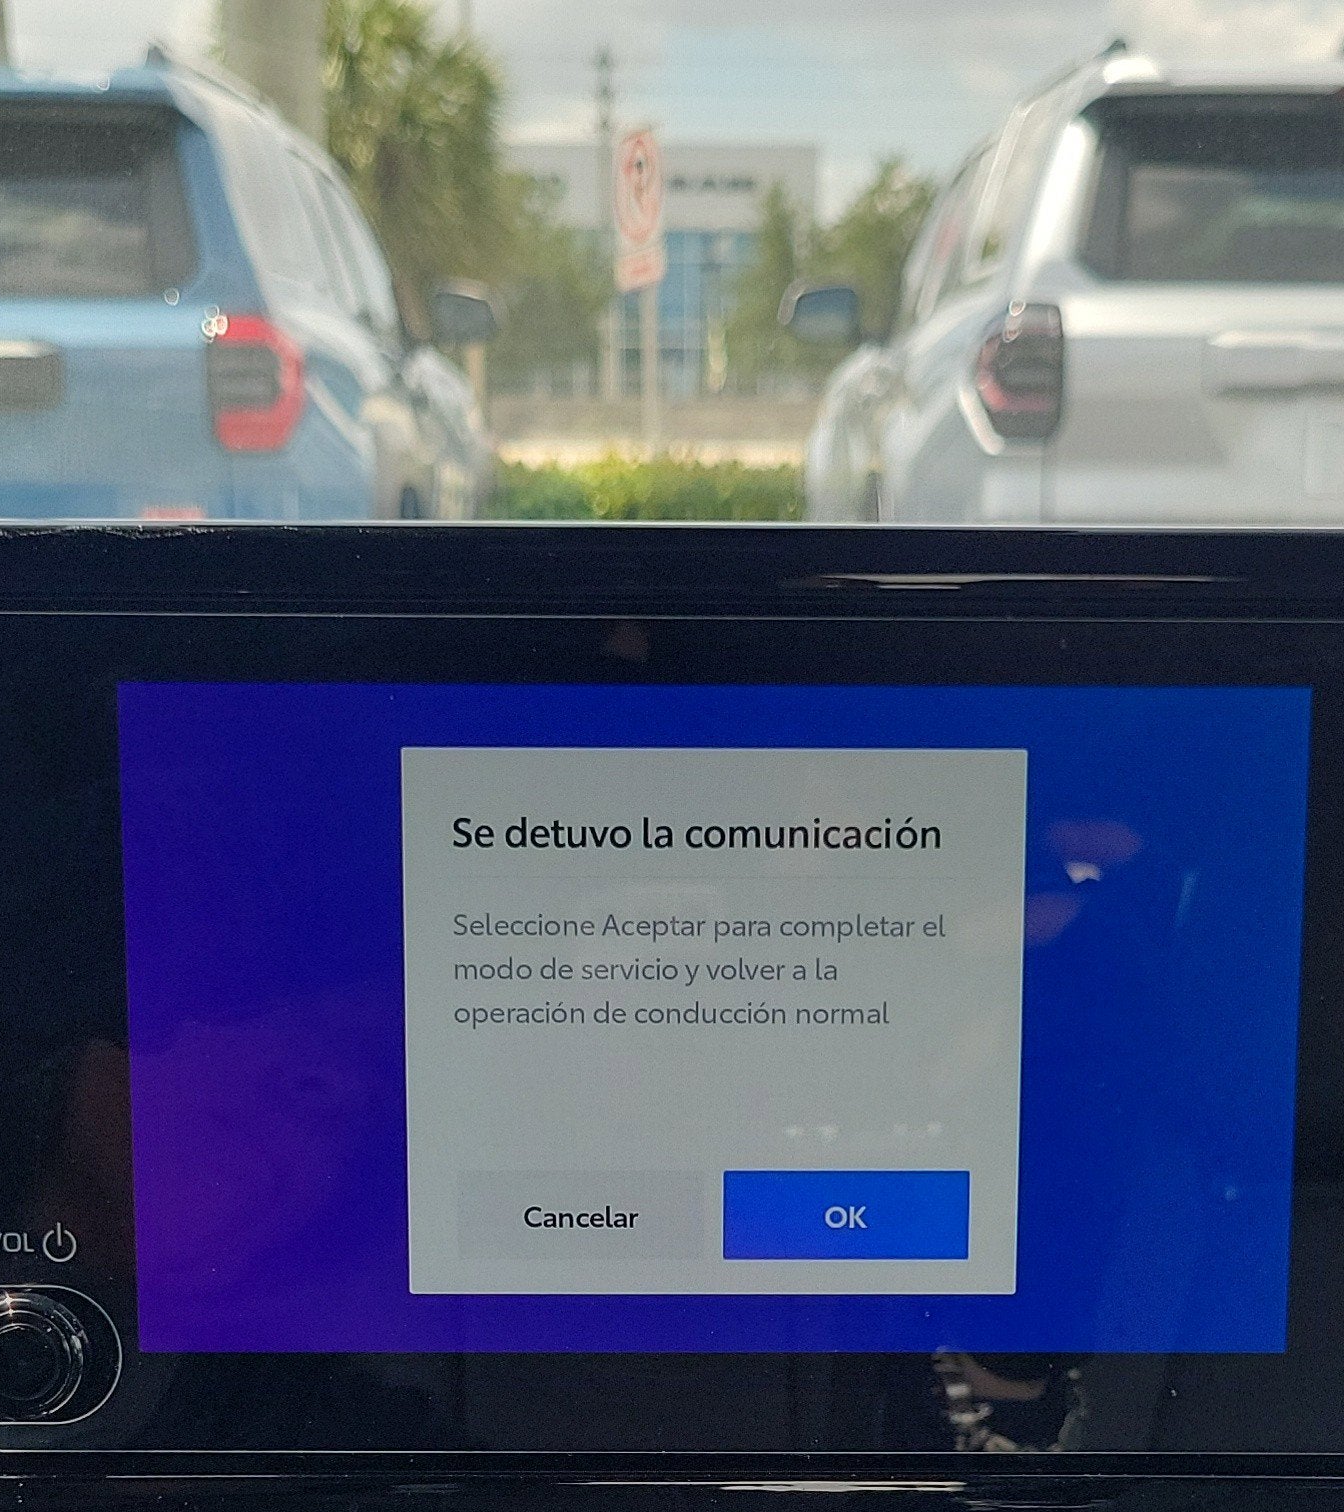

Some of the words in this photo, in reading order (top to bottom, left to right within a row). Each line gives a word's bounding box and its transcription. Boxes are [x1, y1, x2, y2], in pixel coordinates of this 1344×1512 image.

[452, 817, 495, 849] Se
[504, 816, 632, 849] detuvo
[642, 816, 674, 849] la
[684, 817, 942, 850] comunicación
[453, 912, 596, 937] Seleccione
[601, 913, 706, 943] Aceptar
[714, 920, 771, 943] para
[779, 913, 916, 944] completar
[922, 914, 946, 938] el
[454, 956, 533, 981] modo
[539, 957, 574, 981] de
[581, 957, 679, 981] servicio
[684, 964, 700, 987] y
[706, 957, 786, 981] volver
[792, 964, 807, 981] a
[815, 957, 838, 981] la
[453, 1001, 586, 1030] operación
[593, 1001, 627, 1025] de
[634, 1001, 787, 1025] conducción
[795, 1001, 891, 1025] normal
[523, 1205, 639, 1230] Cancelar
[824, 1205, 868, 1230] OK
